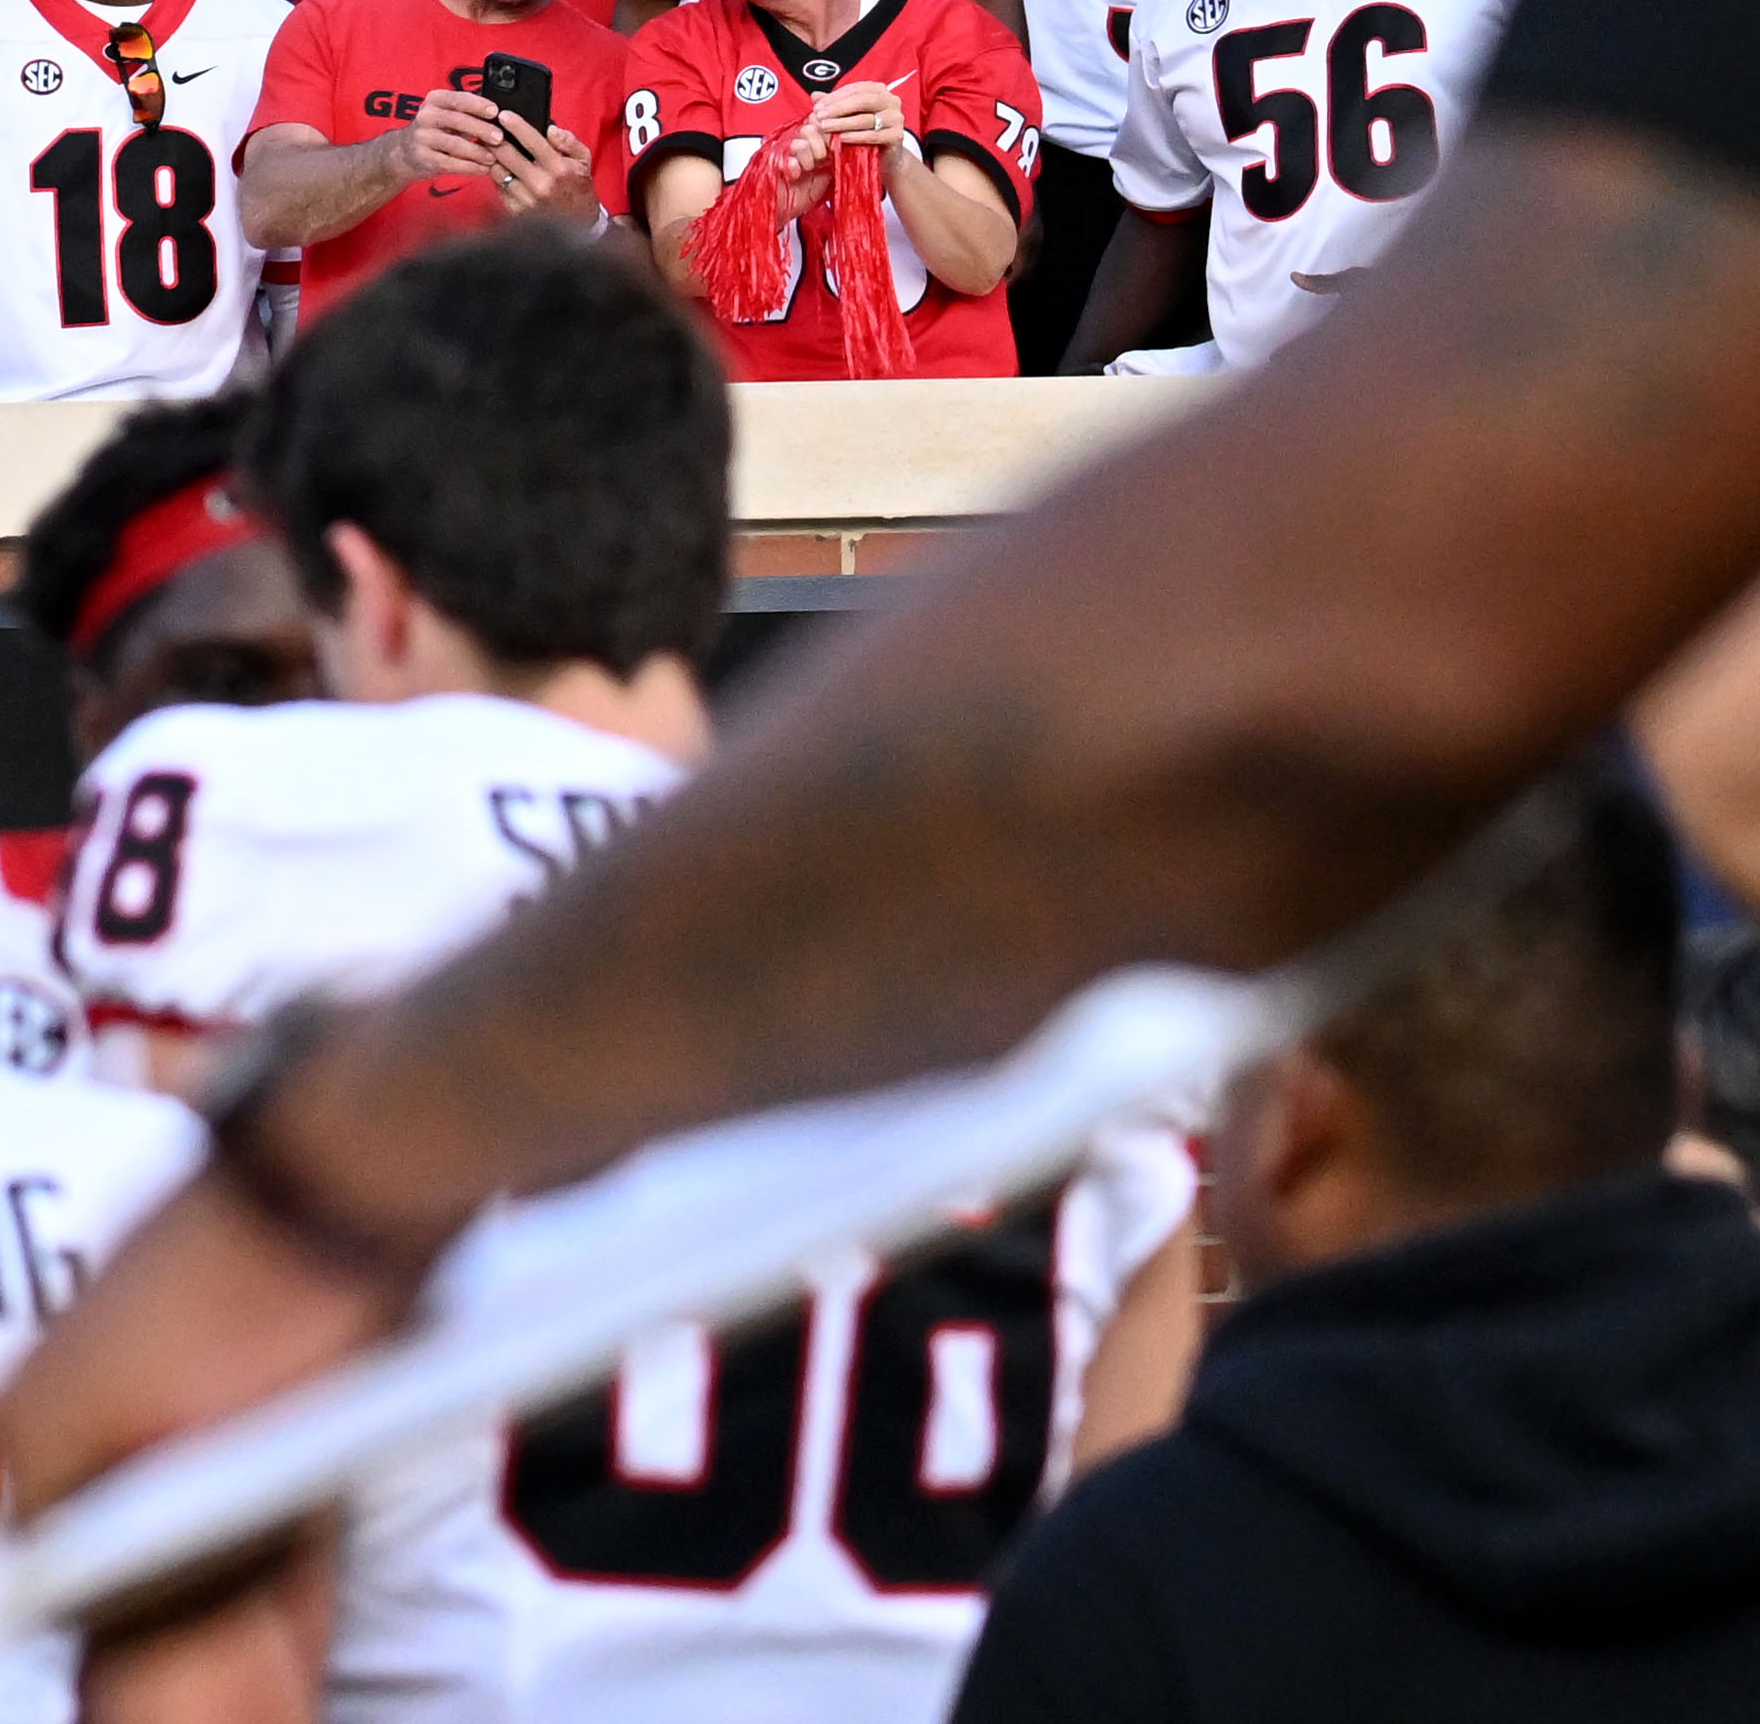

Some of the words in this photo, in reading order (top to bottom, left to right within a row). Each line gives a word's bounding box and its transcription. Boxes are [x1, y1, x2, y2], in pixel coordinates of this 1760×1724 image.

[22, 61, 62, 93] SEC
[736, 67, 778, 102] SEC
[809, 63, 839, 77] G
[1212, 2, 1440, 222] 56
[30, 126, 218, 327] 18
